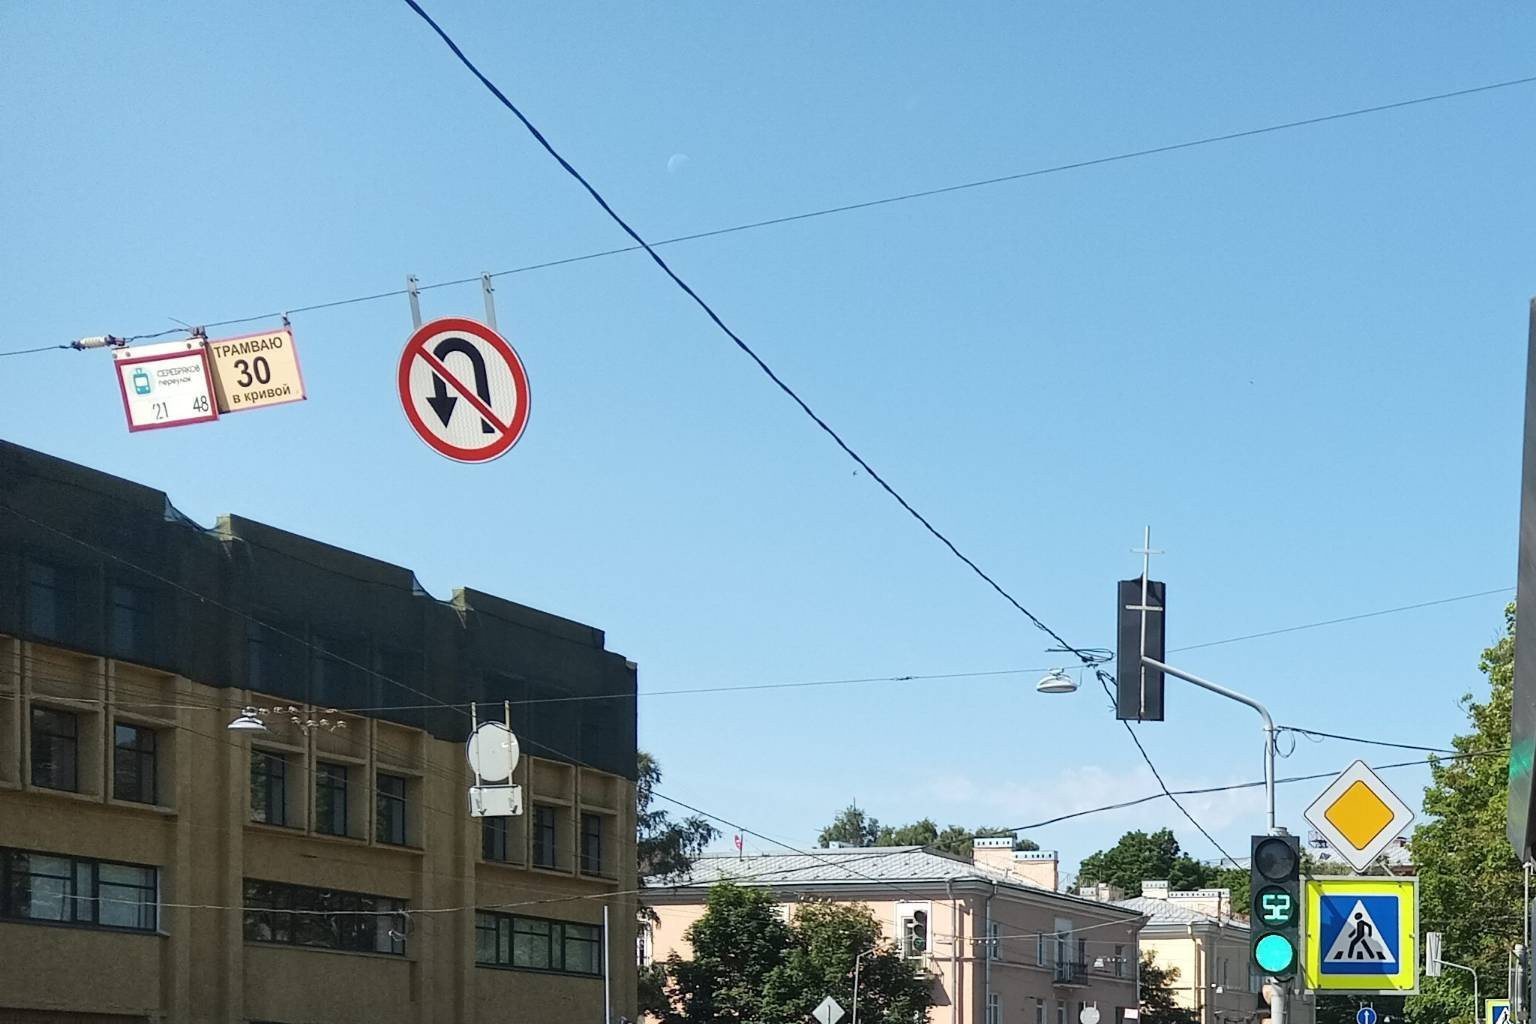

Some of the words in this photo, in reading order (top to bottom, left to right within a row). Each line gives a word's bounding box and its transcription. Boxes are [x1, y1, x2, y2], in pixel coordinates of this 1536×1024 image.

[213, 337, 283, 358] ТРАМВАЮ
[234, 356, 271, 387] 30
[193, 395, 209, 412] 48
[233, 394, 241, 404] в
[244, 383, 291, 403] кривой
